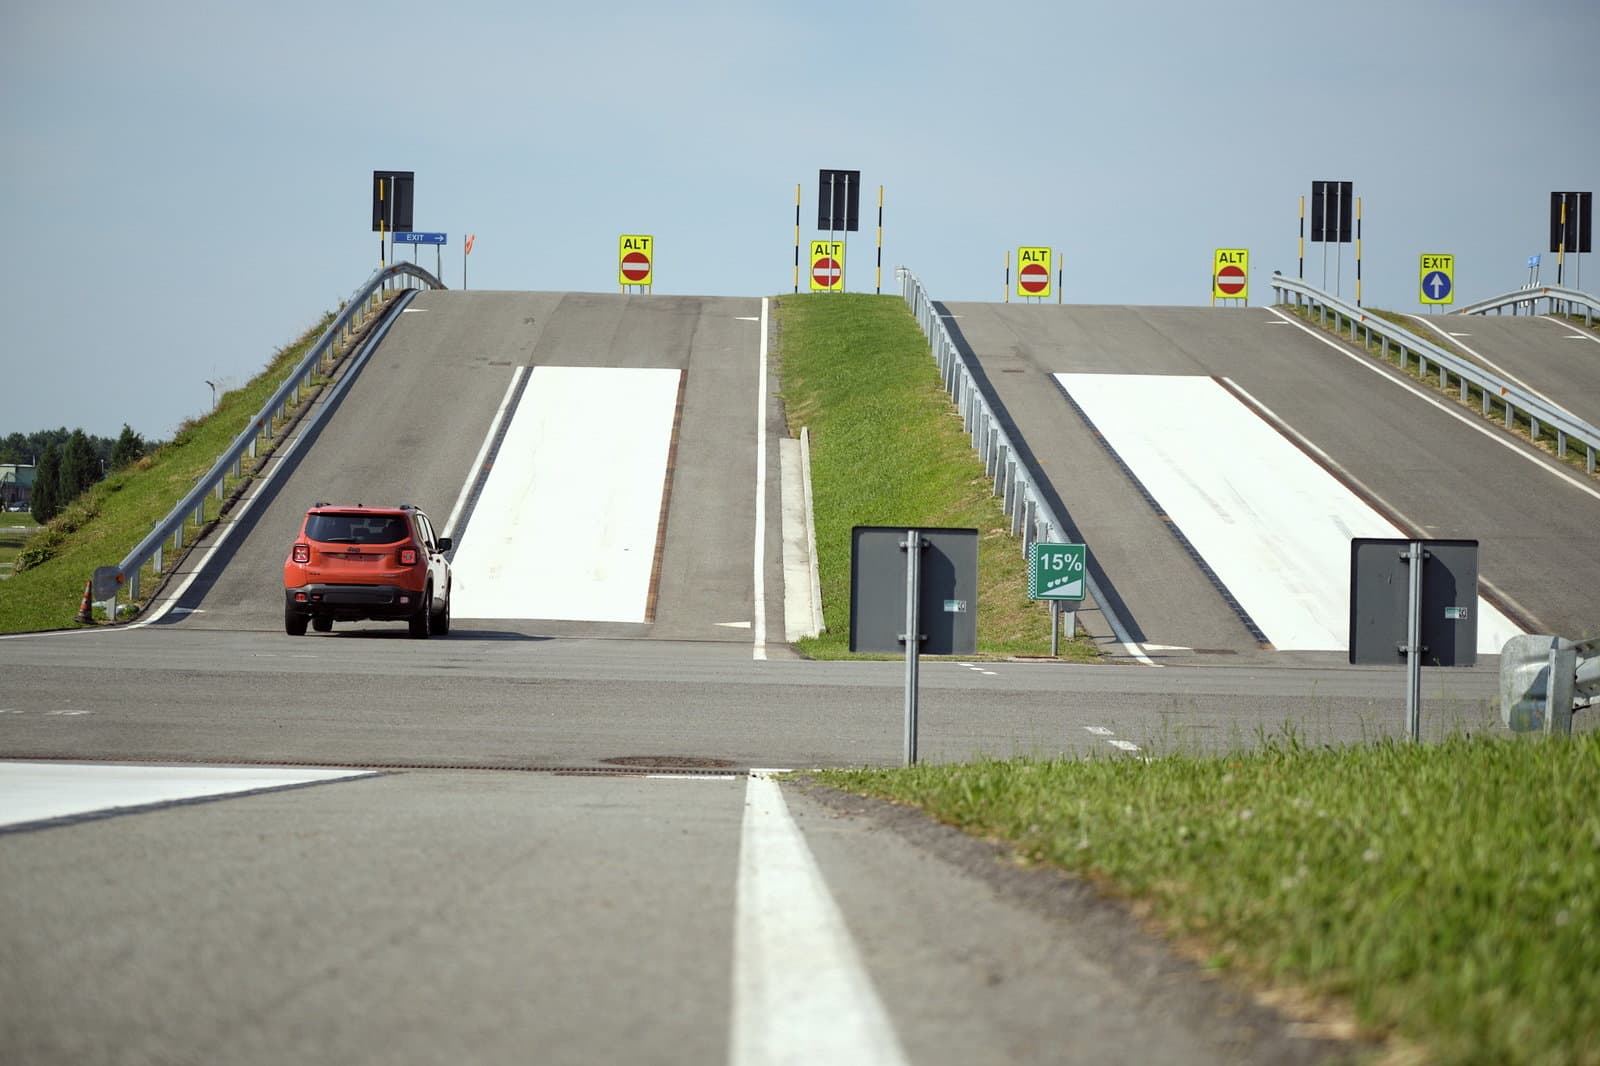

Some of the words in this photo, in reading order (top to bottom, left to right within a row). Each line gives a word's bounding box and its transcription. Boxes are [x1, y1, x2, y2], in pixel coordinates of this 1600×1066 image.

[624, 239, 649, 250] ALT
[815, 244, 840, 255] ALT
[1022, 250, 1048, 261] ALT
[1219, 252, 1245, 263] ALT
[1423, 257, 1451, 268] EXIT
[1040, 553, 1082, 571] 15%
